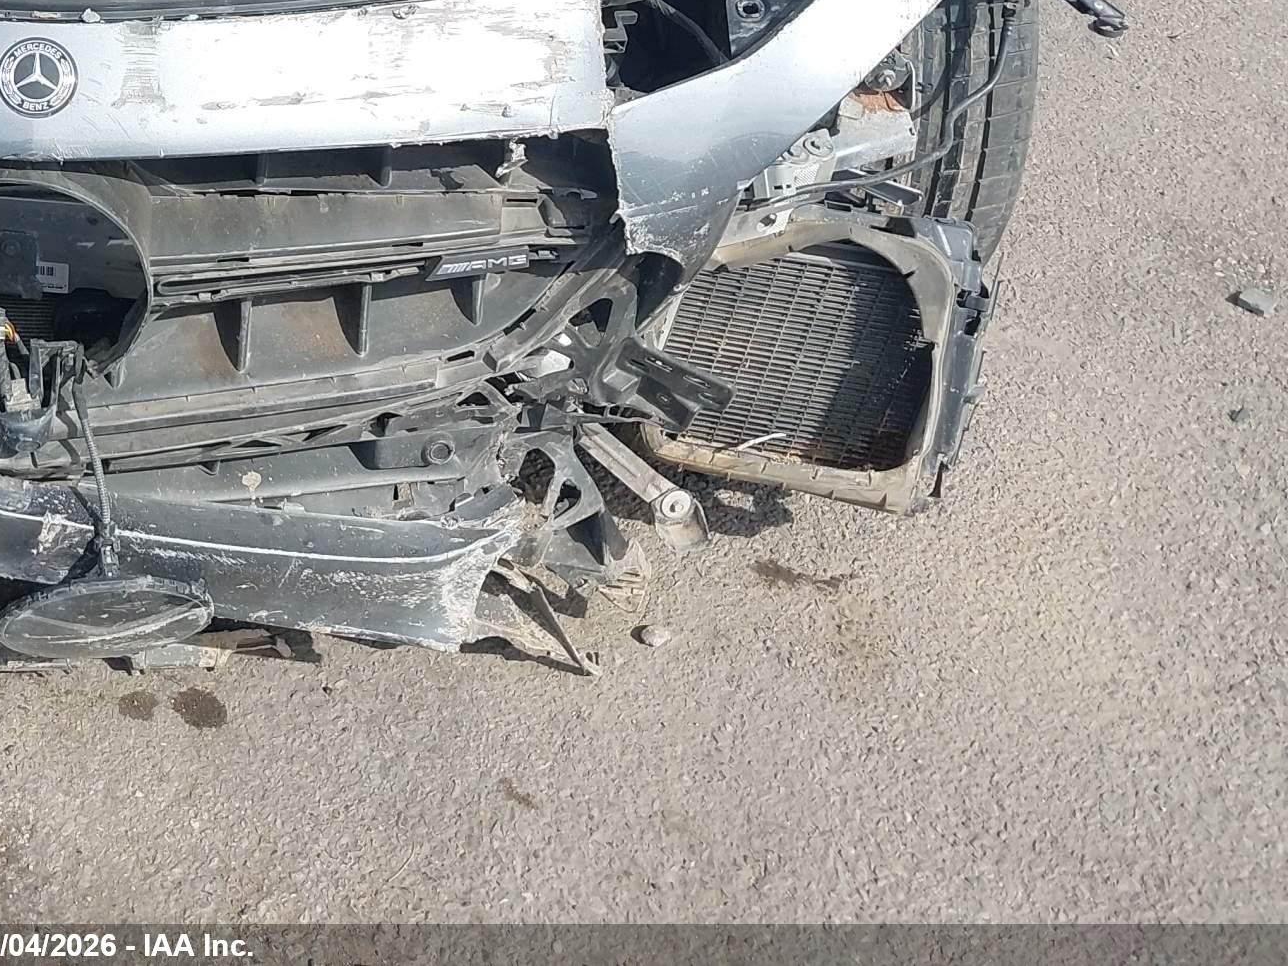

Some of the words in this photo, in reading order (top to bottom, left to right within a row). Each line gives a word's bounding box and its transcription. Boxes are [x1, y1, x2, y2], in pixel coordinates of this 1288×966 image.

[13, 42, 62, 60] MERCEDES
[22, 101, 50, 111] BENZ
[469, 254, 528, 270] AMG
